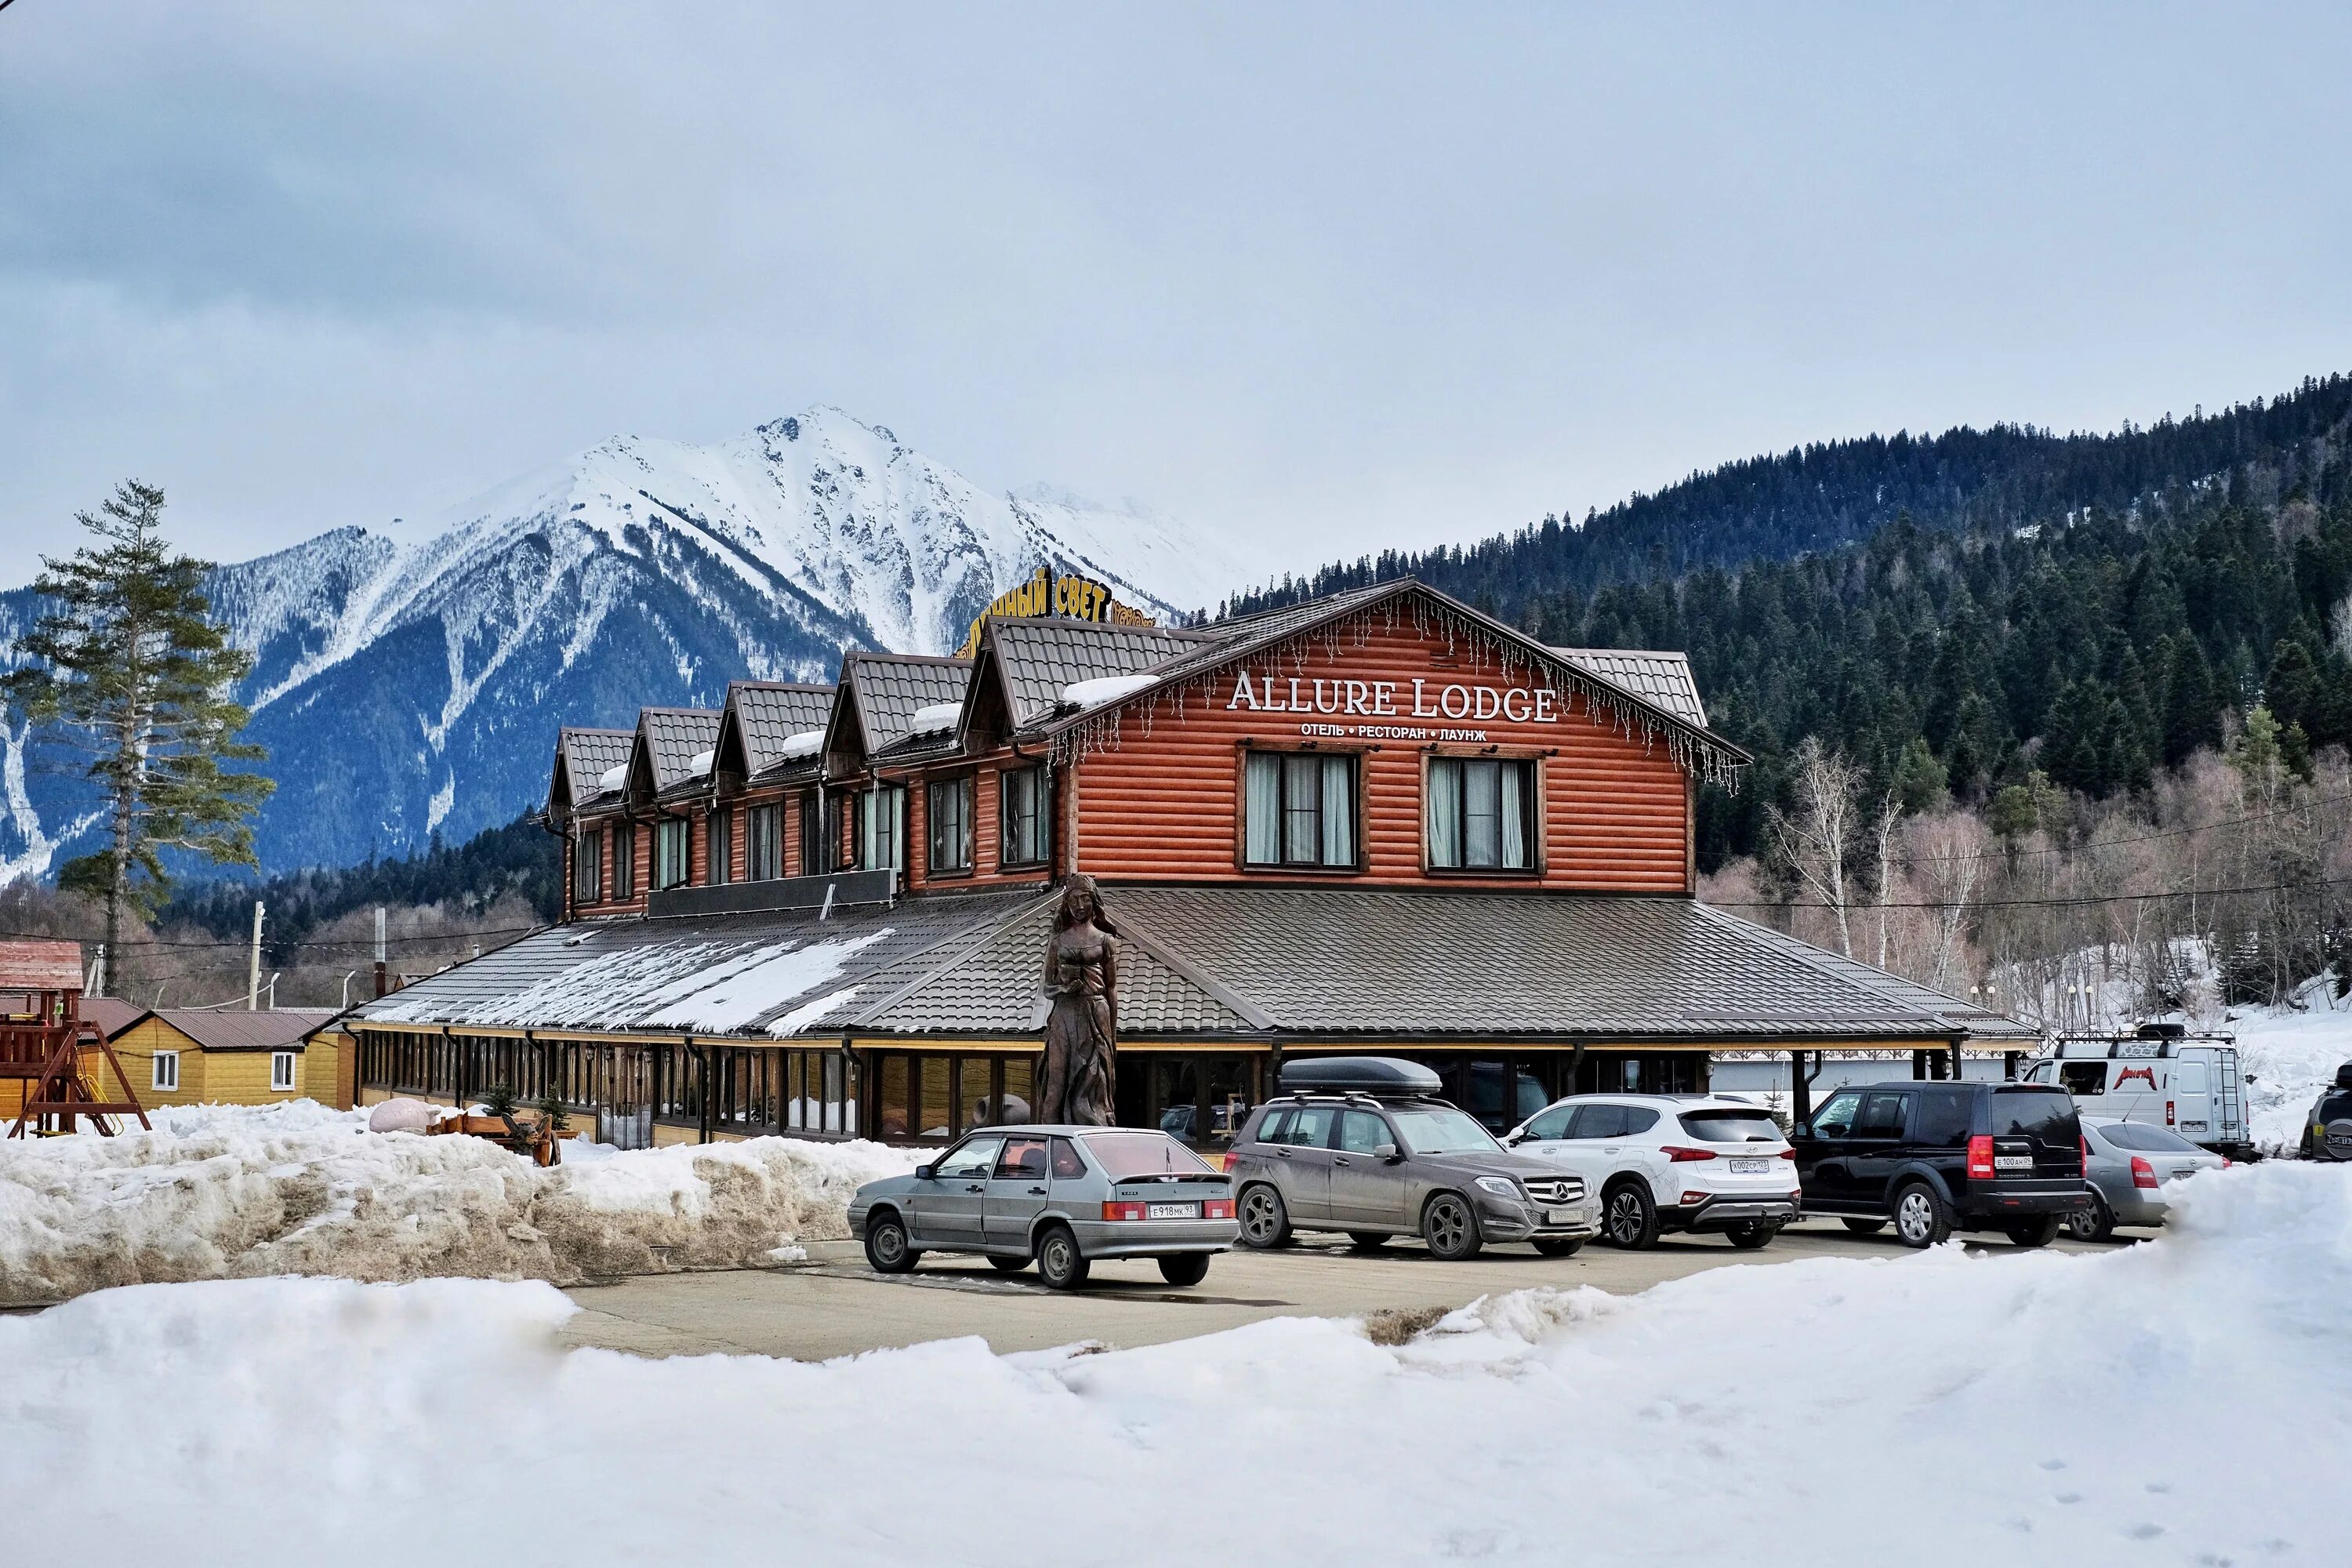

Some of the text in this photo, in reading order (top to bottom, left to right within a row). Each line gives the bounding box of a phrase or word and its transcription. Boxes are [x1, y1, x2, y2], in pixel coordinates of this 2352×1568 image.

[1056, 576, 1106, 622] СВЕТ
[1226, 670, 1557, 722] ALLURE LODGE
[1301, 723, 1487, 741] ОТЕЛЬ РЕСТОРАН ЛАУНЖ
